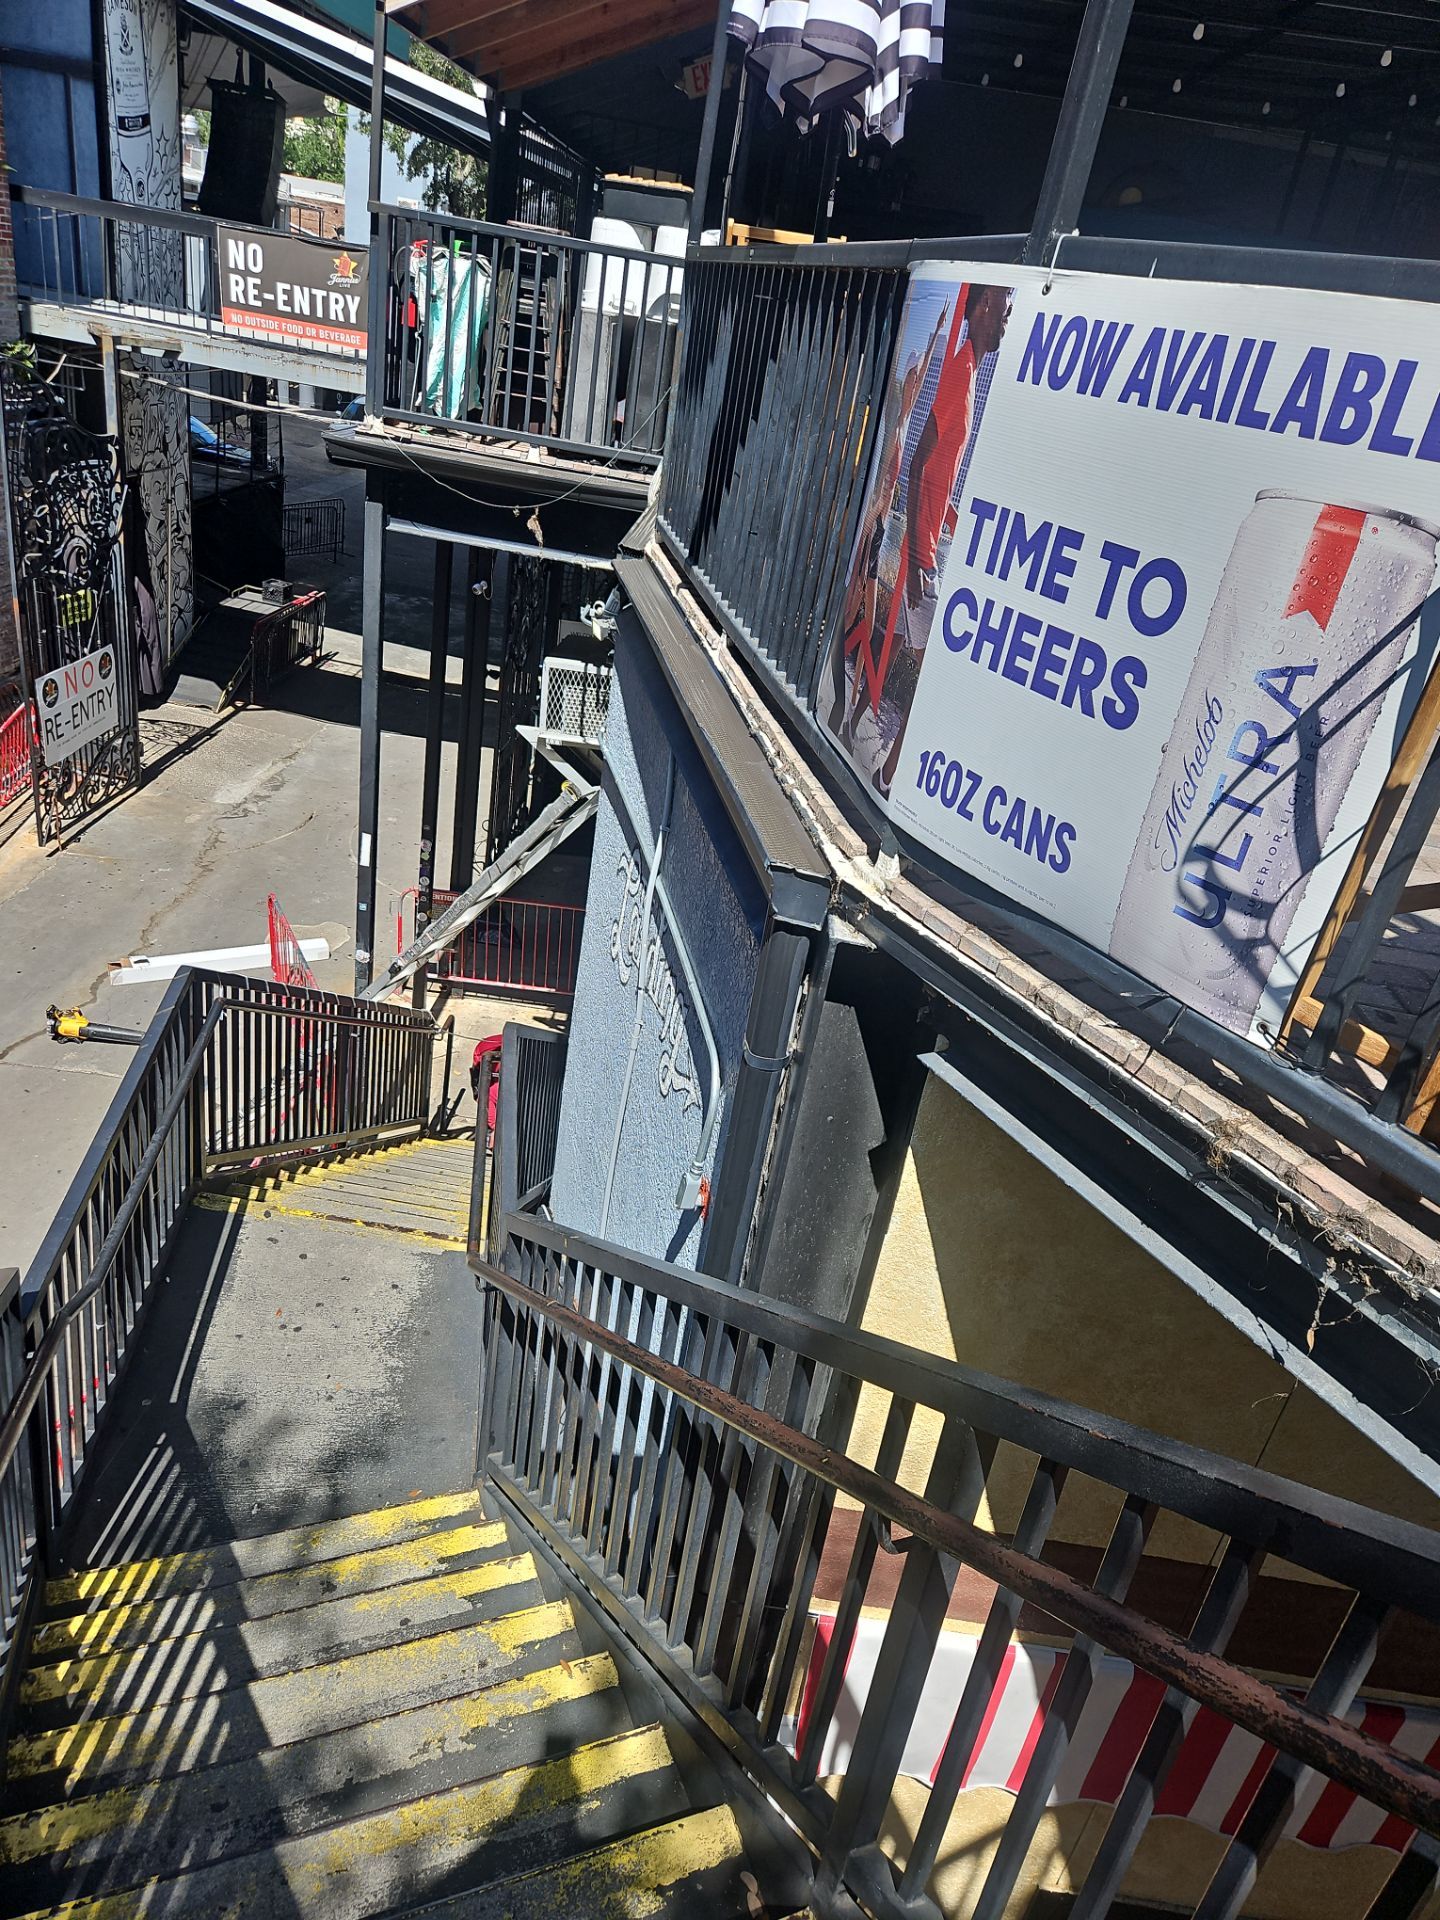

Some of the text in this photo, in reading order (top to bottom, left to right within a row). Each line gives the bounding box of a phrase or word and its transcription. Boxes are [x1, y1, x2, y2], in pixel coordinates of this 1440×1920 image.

[227, 239, 264, 274] NO
[228, 273, 361, 325] RE-ENTRY
[231, 313, 361, 346] NO OUTSIDE FOOD OR BEVERAGE
[1016, 311, 1134, 398] NOW
[965, 497, 1187, 637] TIME TO
[63, 660, 95, 699] NO
[942, 587, 1148, 731] CHEERS
[44, 683, 115, 745] RE-ENTRY
[916, 750, 983, 822] 16OZ
[982, 785, 1077, 874] CANS
[1155, 686, 1224, 873] Michelob
[1172, 664, 1319, 929] ULTRA
[1243, 716, 1330, 918] SUPERIOR LIGHT BEER
